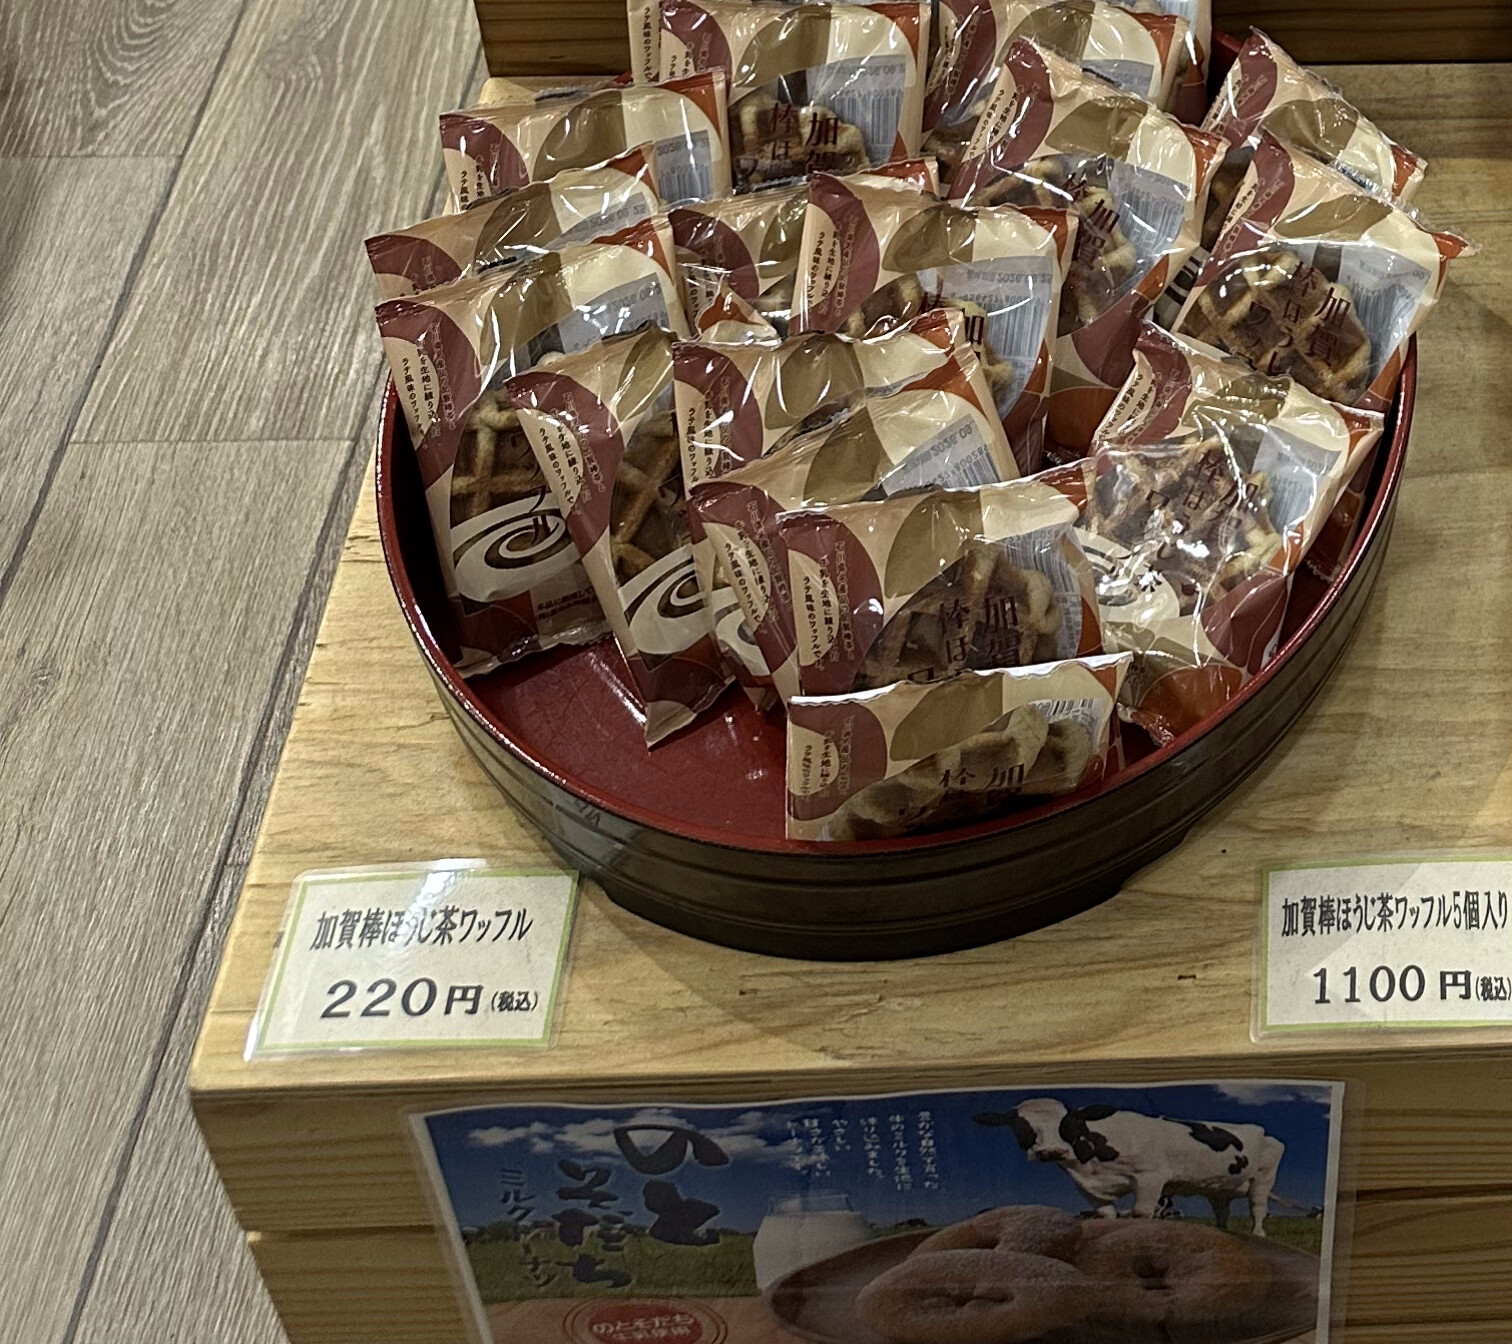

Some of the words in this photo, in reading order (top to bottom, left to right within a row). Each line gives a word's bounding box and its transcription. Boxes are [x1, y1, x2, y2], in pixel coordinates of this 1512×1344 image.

[309, 905, 534, 952] 加賀棒ほうじ茶ワッフル
[1281, 888, 1509, 938] 加賀棒ほうじ茶ワッフル5個入り
[613, 1123, 730, 1247] のと
